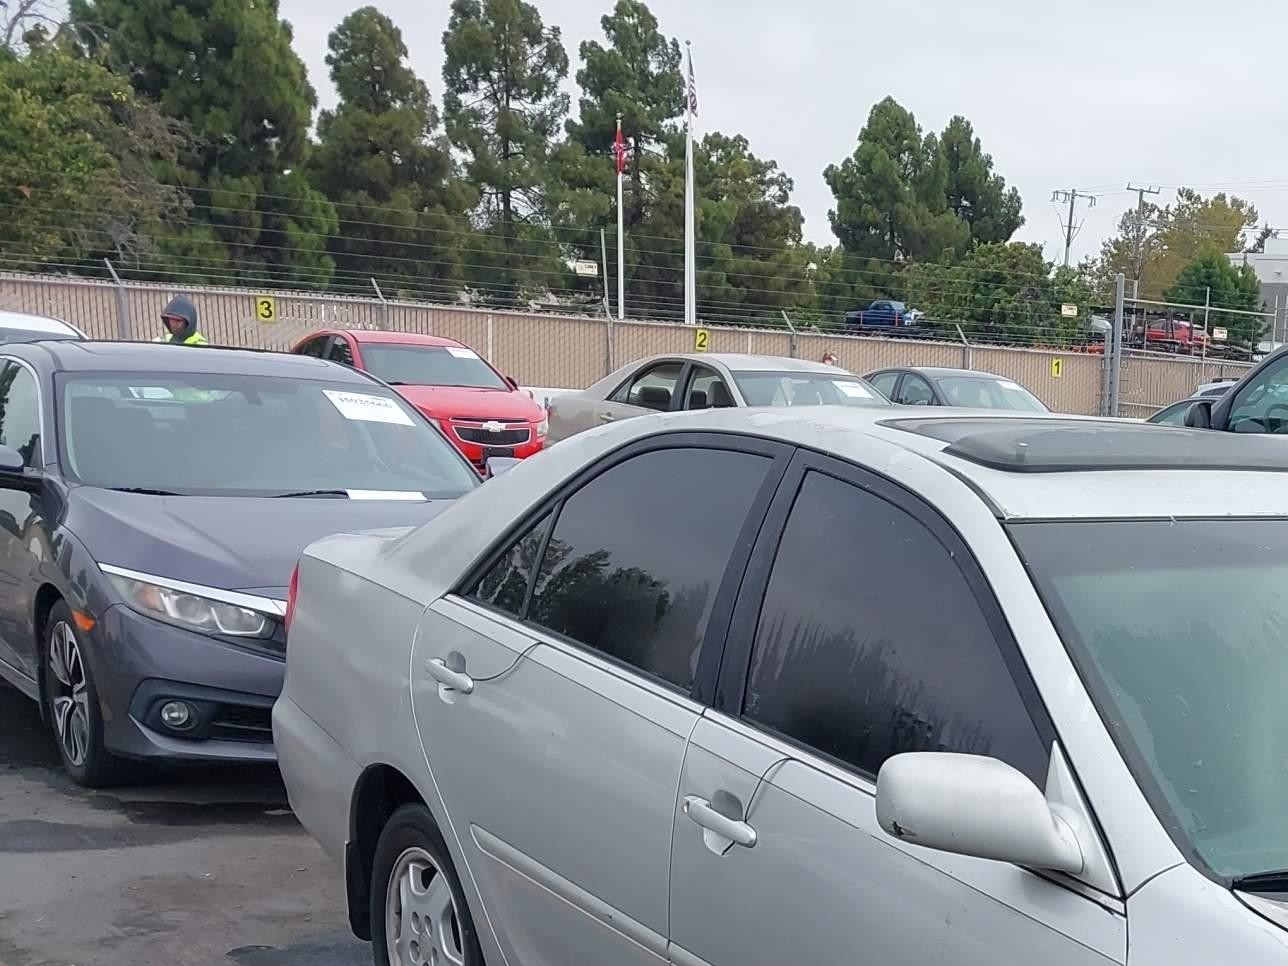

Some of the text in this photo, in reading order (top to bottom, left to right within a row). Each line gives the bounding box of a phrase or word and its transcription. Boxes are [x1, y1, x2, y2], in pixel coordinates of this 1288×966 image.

[260, 300, 273, 319] 3
[697, 332, 707, 348] 2
[1054, 360, 1060, 375] 1
